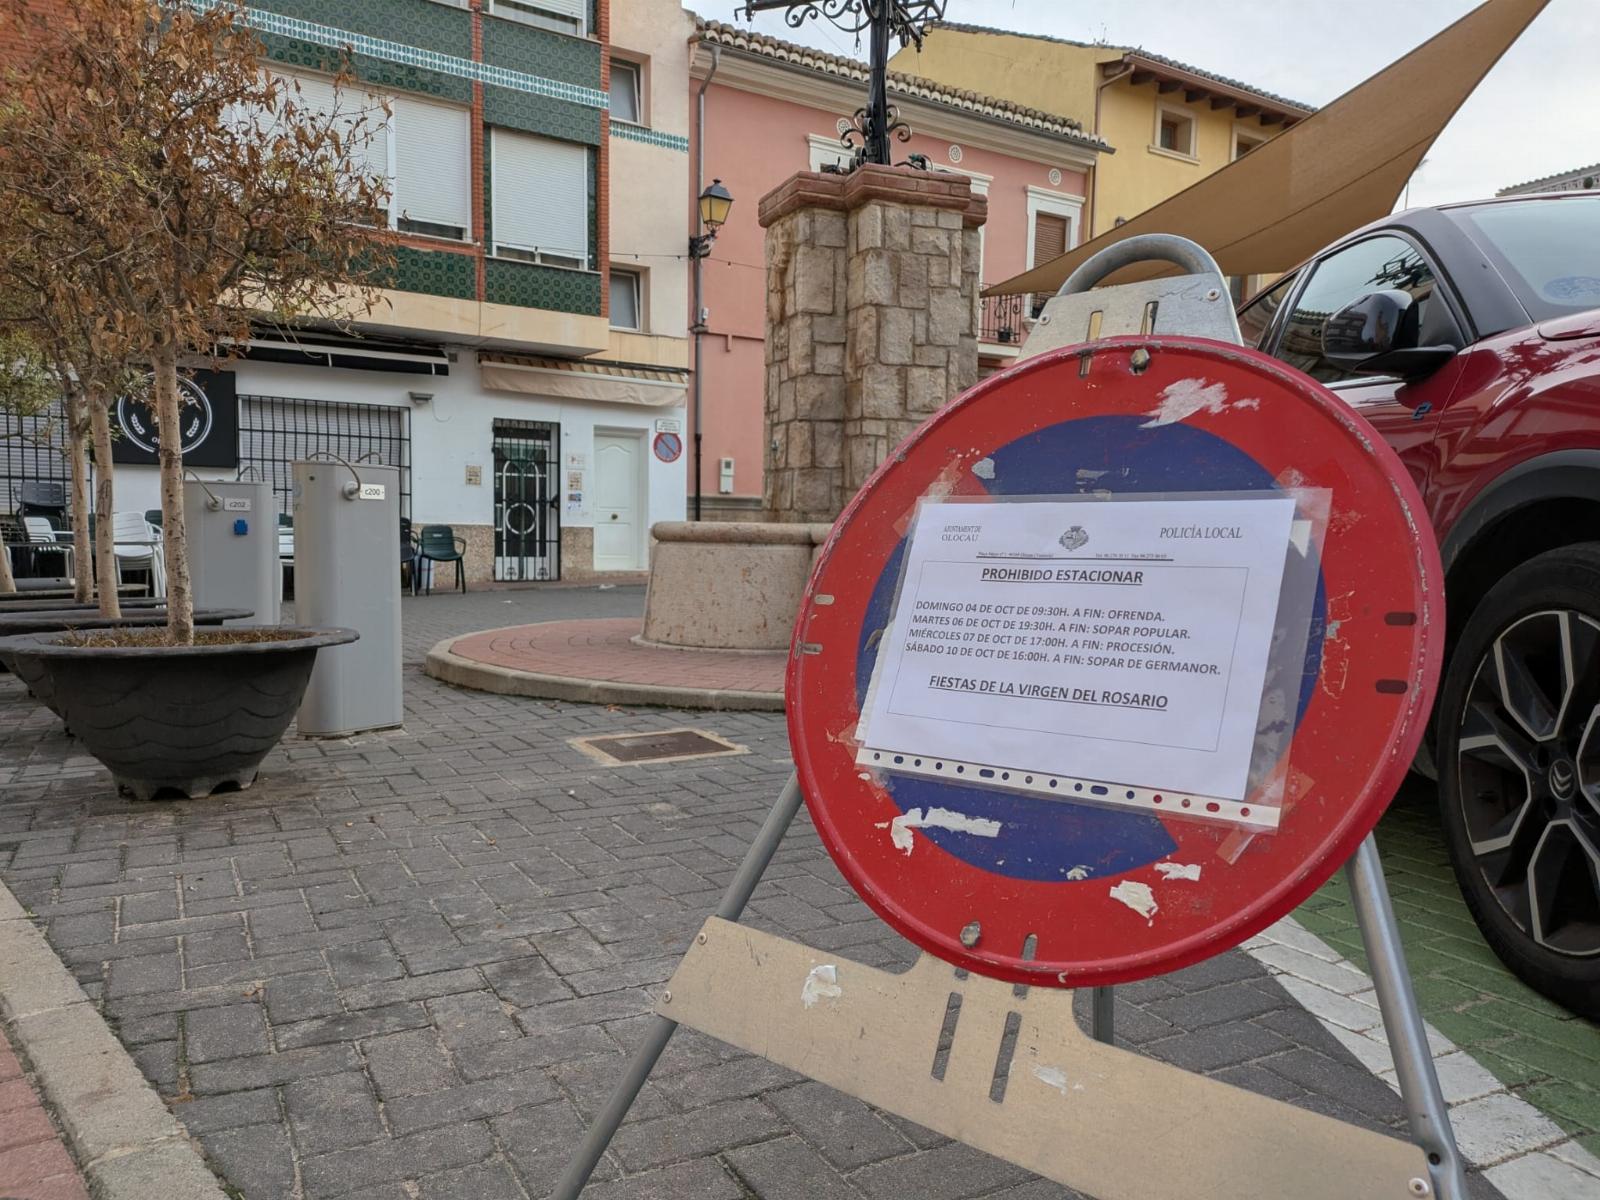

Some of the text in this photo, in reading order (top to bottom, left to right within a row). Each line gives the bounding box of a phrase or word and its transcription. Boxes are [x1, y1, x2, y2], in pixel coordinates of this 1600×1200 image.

[941, 534, 978, 542] OLOCAU
[1160, 524, 1243, 539] POLICÍA LOCAL
[982, 568, 1143, 583] PROHIBIDO ESTACIONAR
[916, 601, 1165, 622] DOMINGO 04 DE OCT DE 09:30H. A FIN: OFRENDA.
[912, 615, 1191, 639] MARTES 06 DE OCT DE 19:30H. A FIN: SOPAR POPULAR.
[909, 628, 1175, 655] MIÉRCOLES 07 DE OCT DE 17:00H. A FIN: PROCESIÓN.
[906, 641, 1221, 675] SÁBADO 10 DE OCT DE 16:00H. A FIN: SOPAR DE GERMANOR.
[929, 675, 1168, 708] FIESTAS DE LA VIRGEN DEL ROSARIO
